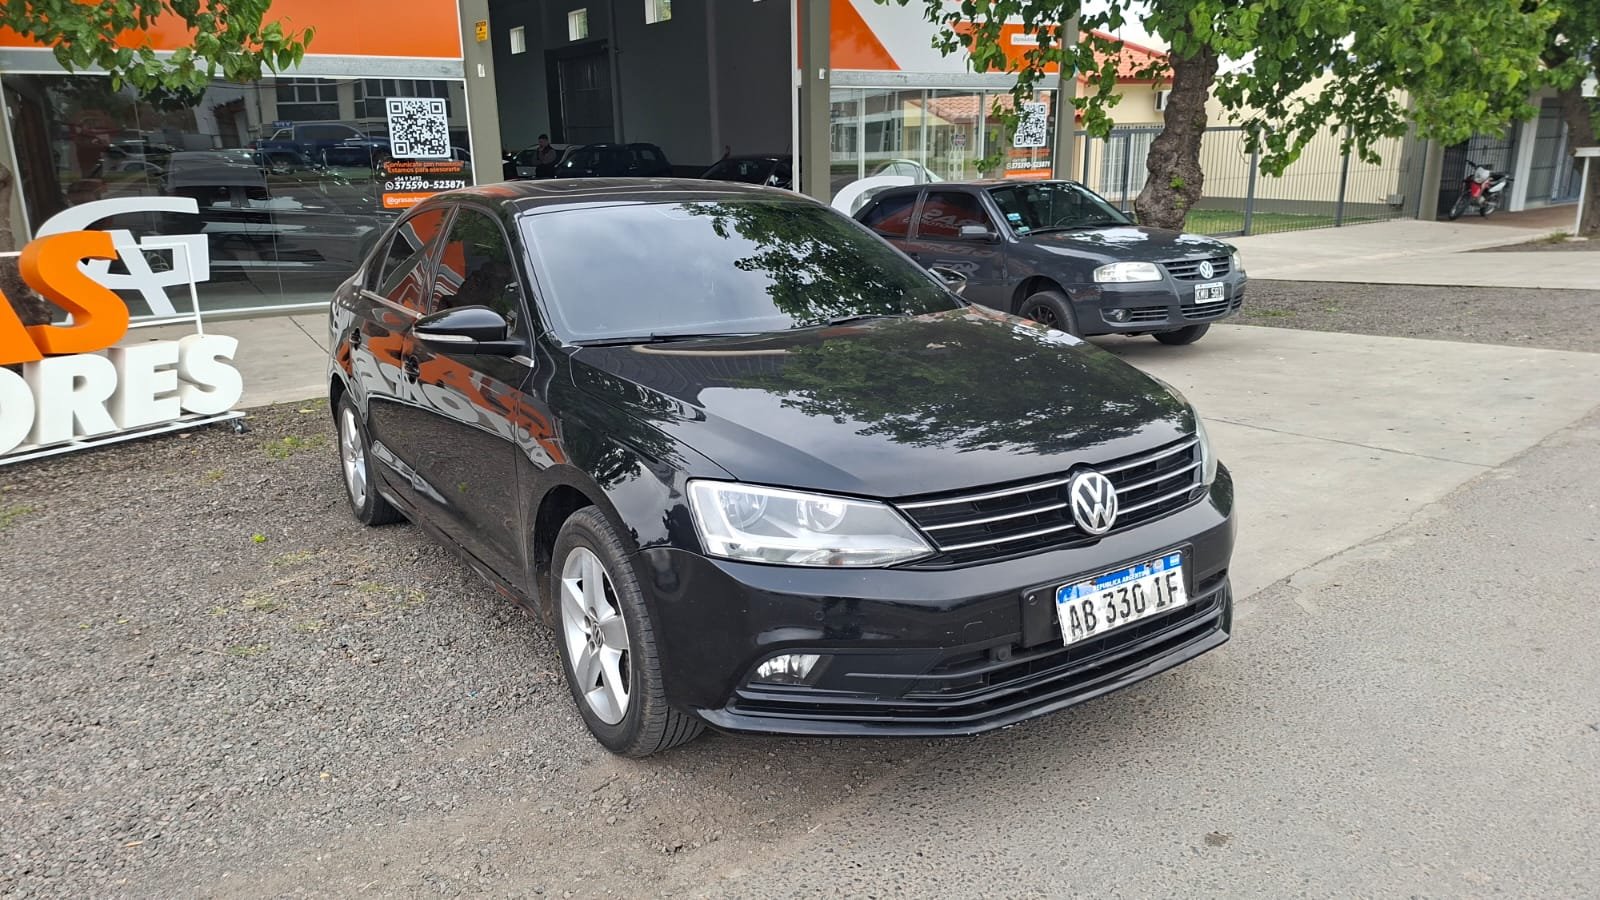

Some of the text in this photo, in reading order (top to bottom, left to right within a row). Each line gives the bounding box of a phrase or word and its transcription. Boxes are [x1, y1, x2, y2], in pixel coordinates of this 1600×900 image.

[394, 180, 465, 190] 375590-523871
[1068, 571, 1178, 640] AB 330 IF
